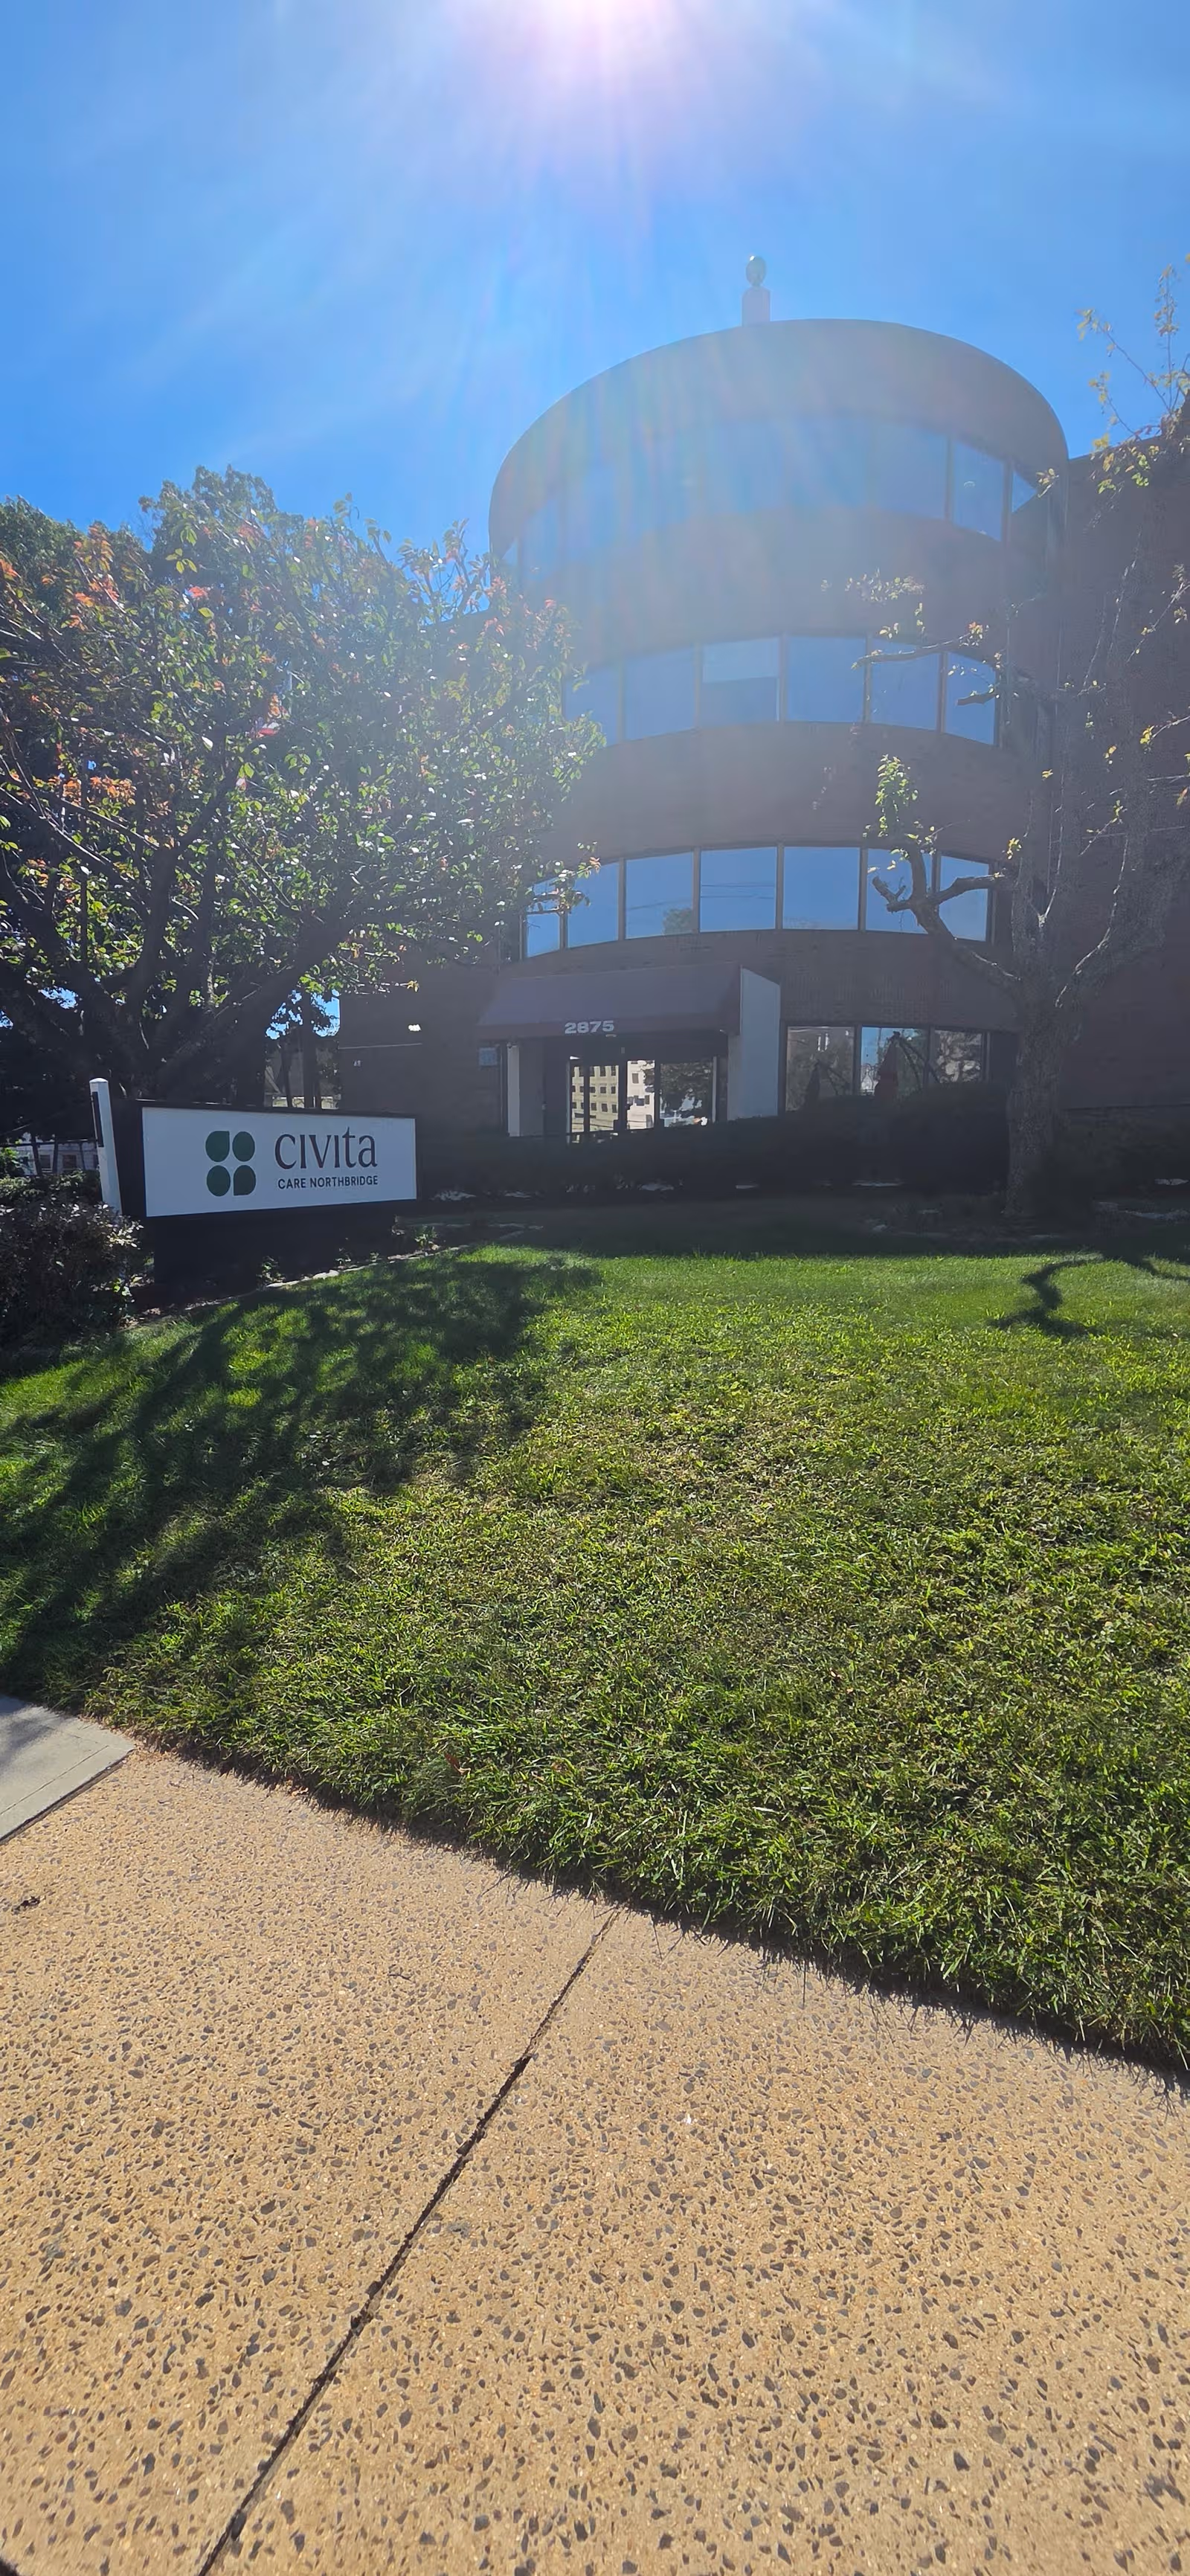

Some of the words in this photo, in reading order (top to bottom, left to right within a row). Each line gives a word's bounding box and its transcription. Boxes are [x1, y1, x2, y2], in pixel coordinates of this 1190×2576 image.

[565, 1020, 614, 1034] 2875
[277, 1178, 306, 1189] CARE
[309, 1175, 378, 1188] NORTHBRIDGE
